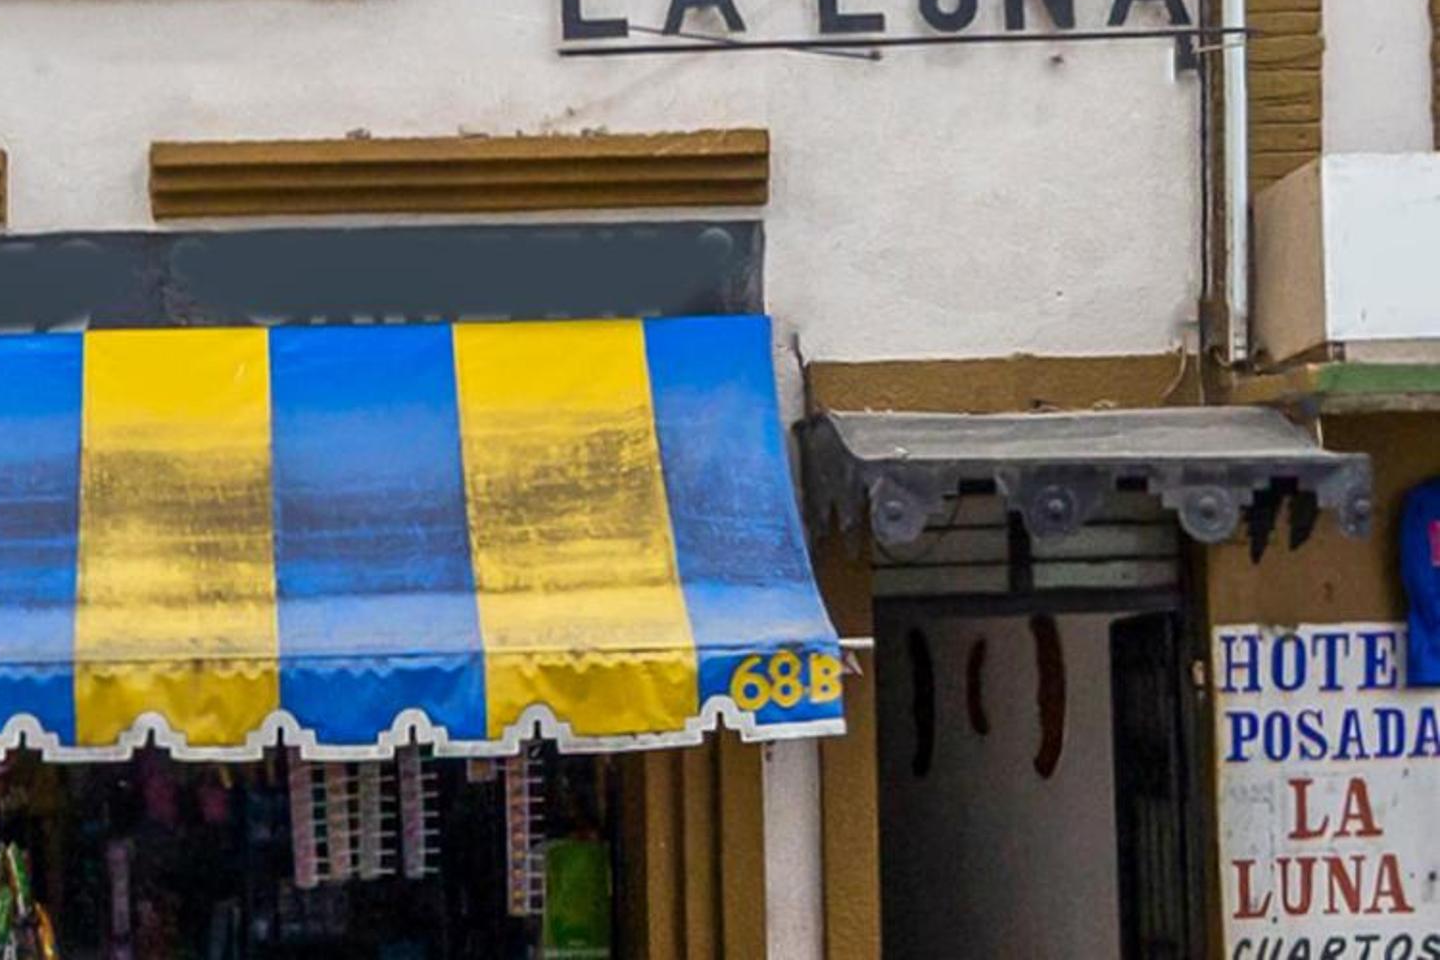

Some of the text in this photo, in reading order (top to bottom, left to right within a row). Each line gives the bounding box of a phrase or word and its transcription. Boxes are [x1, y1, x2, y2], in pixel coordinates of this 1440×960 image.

[731, 650, 844, 711] 68B
[1219, 631, 1408, 694] HOTE
[1224, 707, 1440, 762] POSADA
[1287, 776, 1383, 841] LA
[1231, 852, 1415, 920] LUNA
